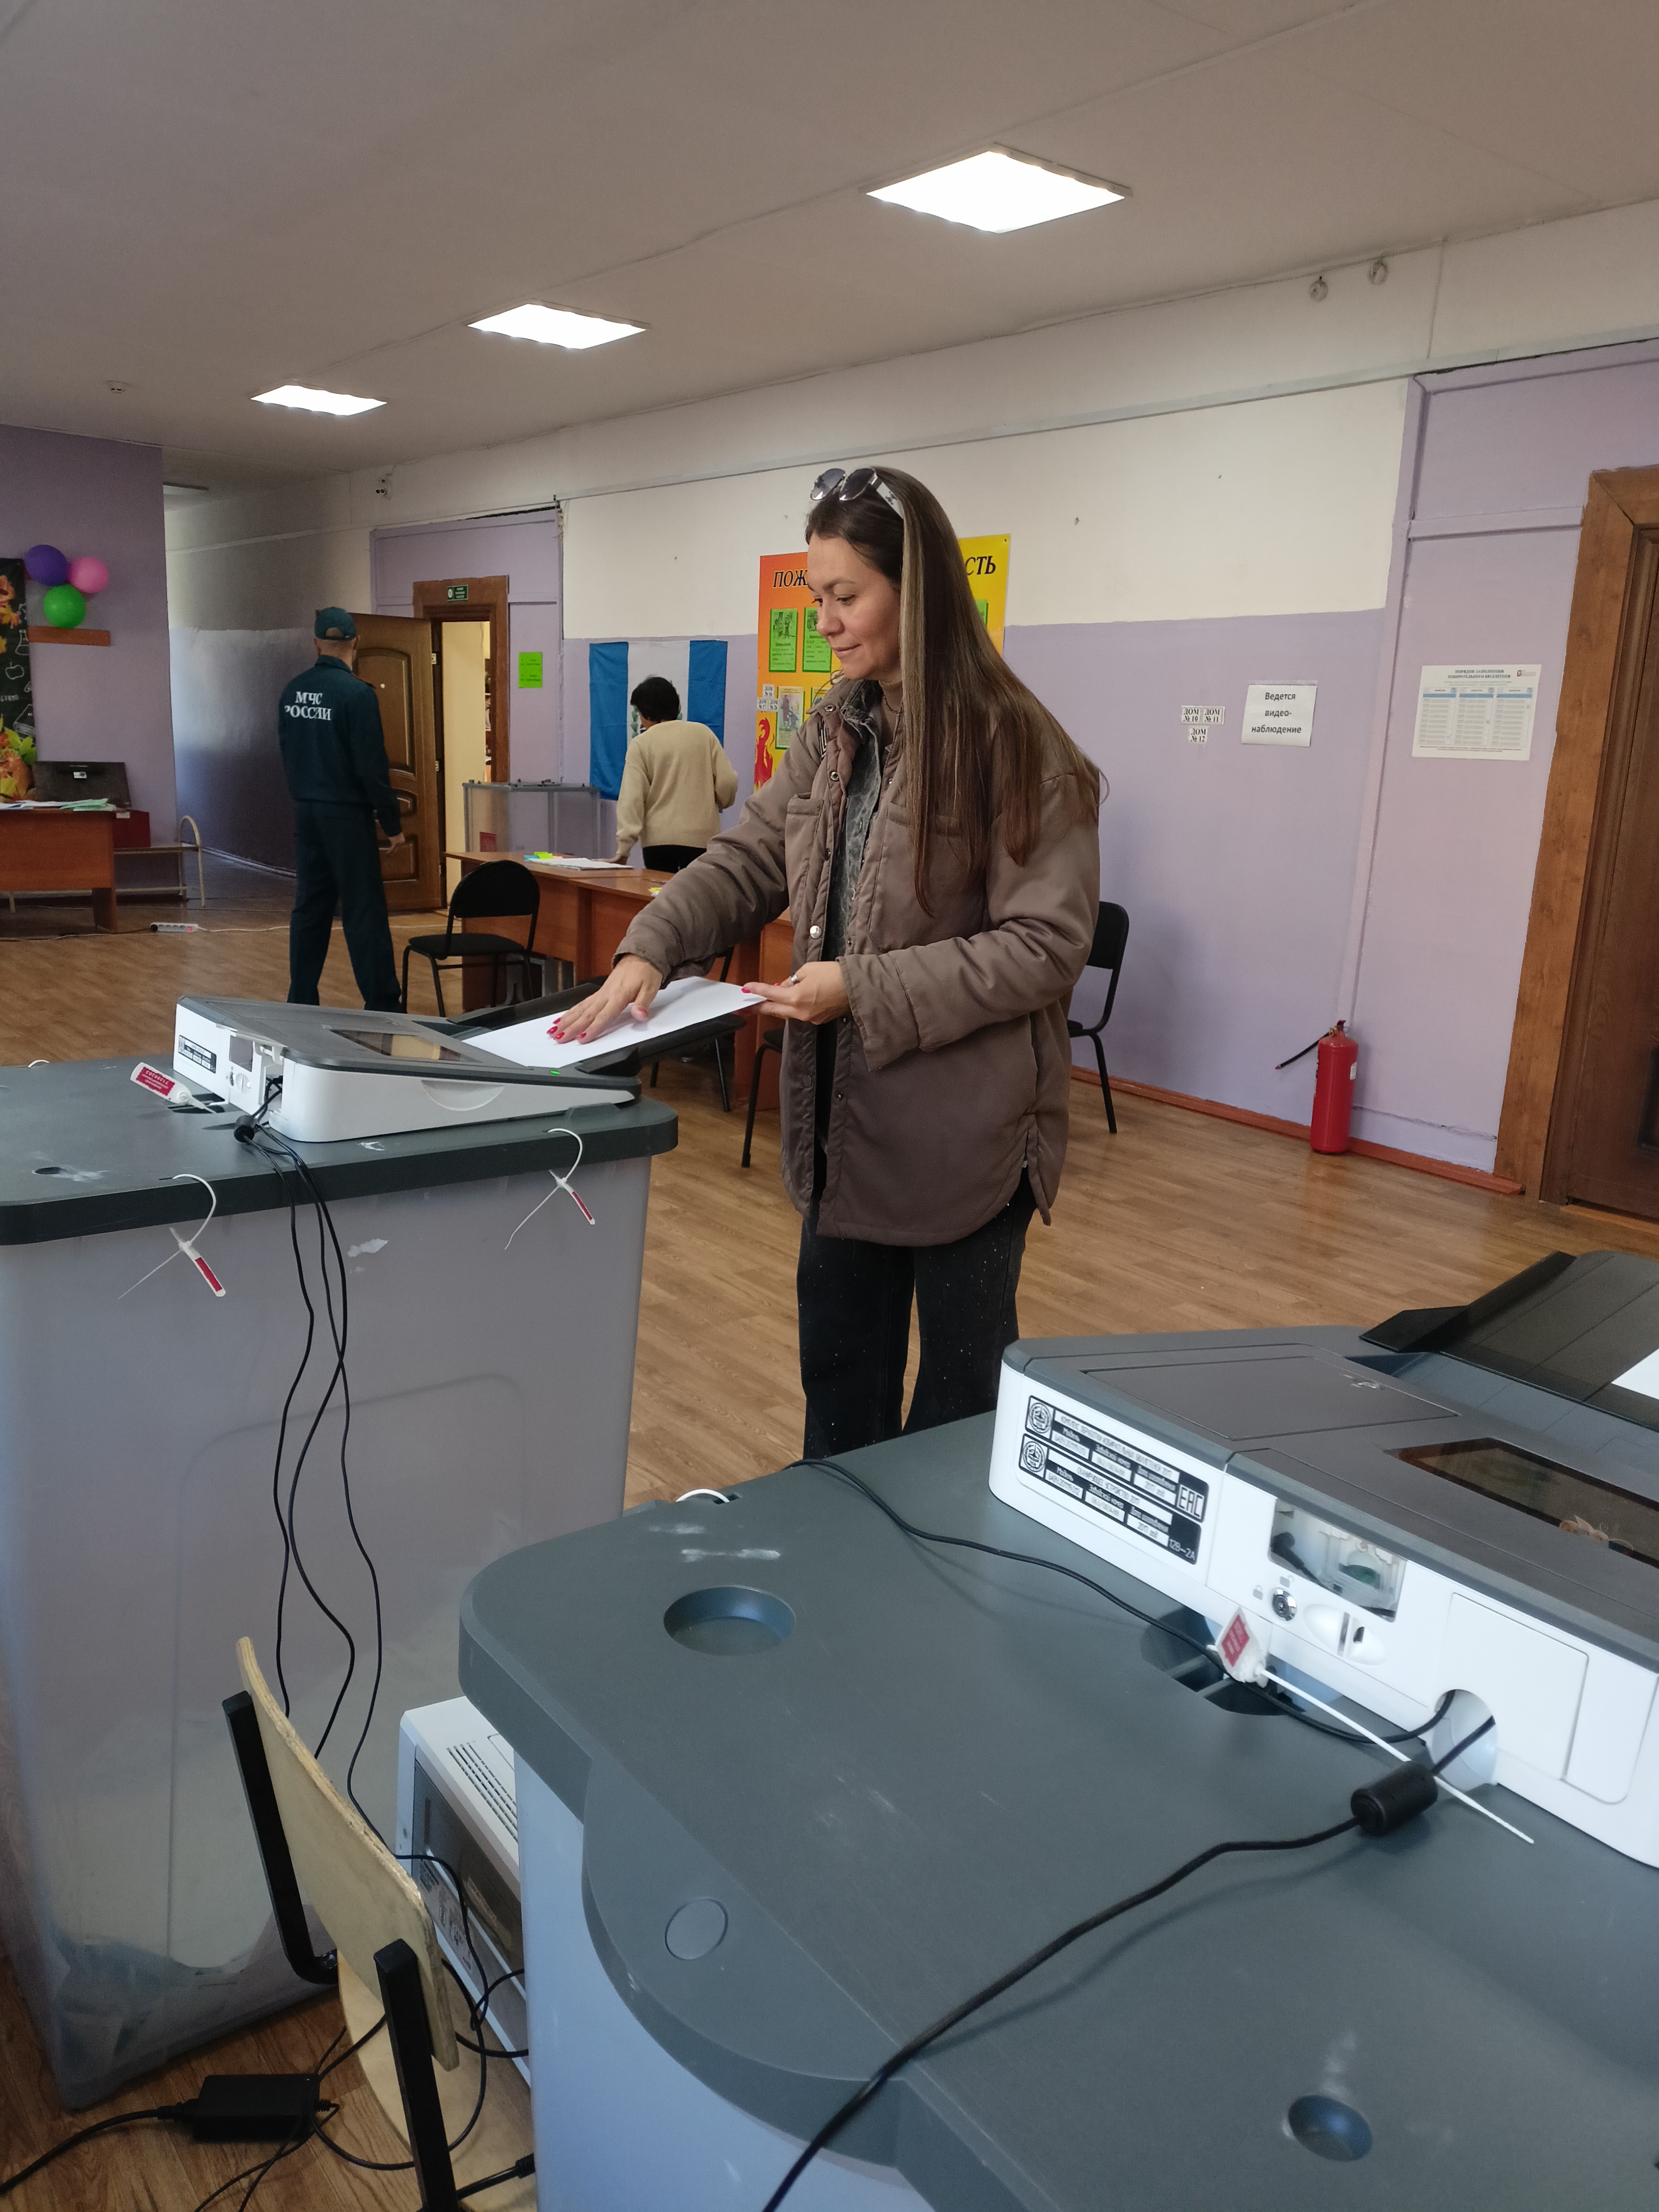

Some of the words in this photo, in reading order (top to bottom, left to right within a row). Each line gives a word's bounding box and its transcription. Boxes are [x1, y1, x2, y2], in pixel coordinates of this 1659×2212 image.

[773, 569, 808, 587] ПОЖ
[965, 555, 996, 576] СТЬ
[295, 691, 323, 705] МЧС
[1264, 692, 1296, 702] Ведется
[1264, 709, 1292, 719] видео-
[1251, 724, 1302, 734] наблюдение
